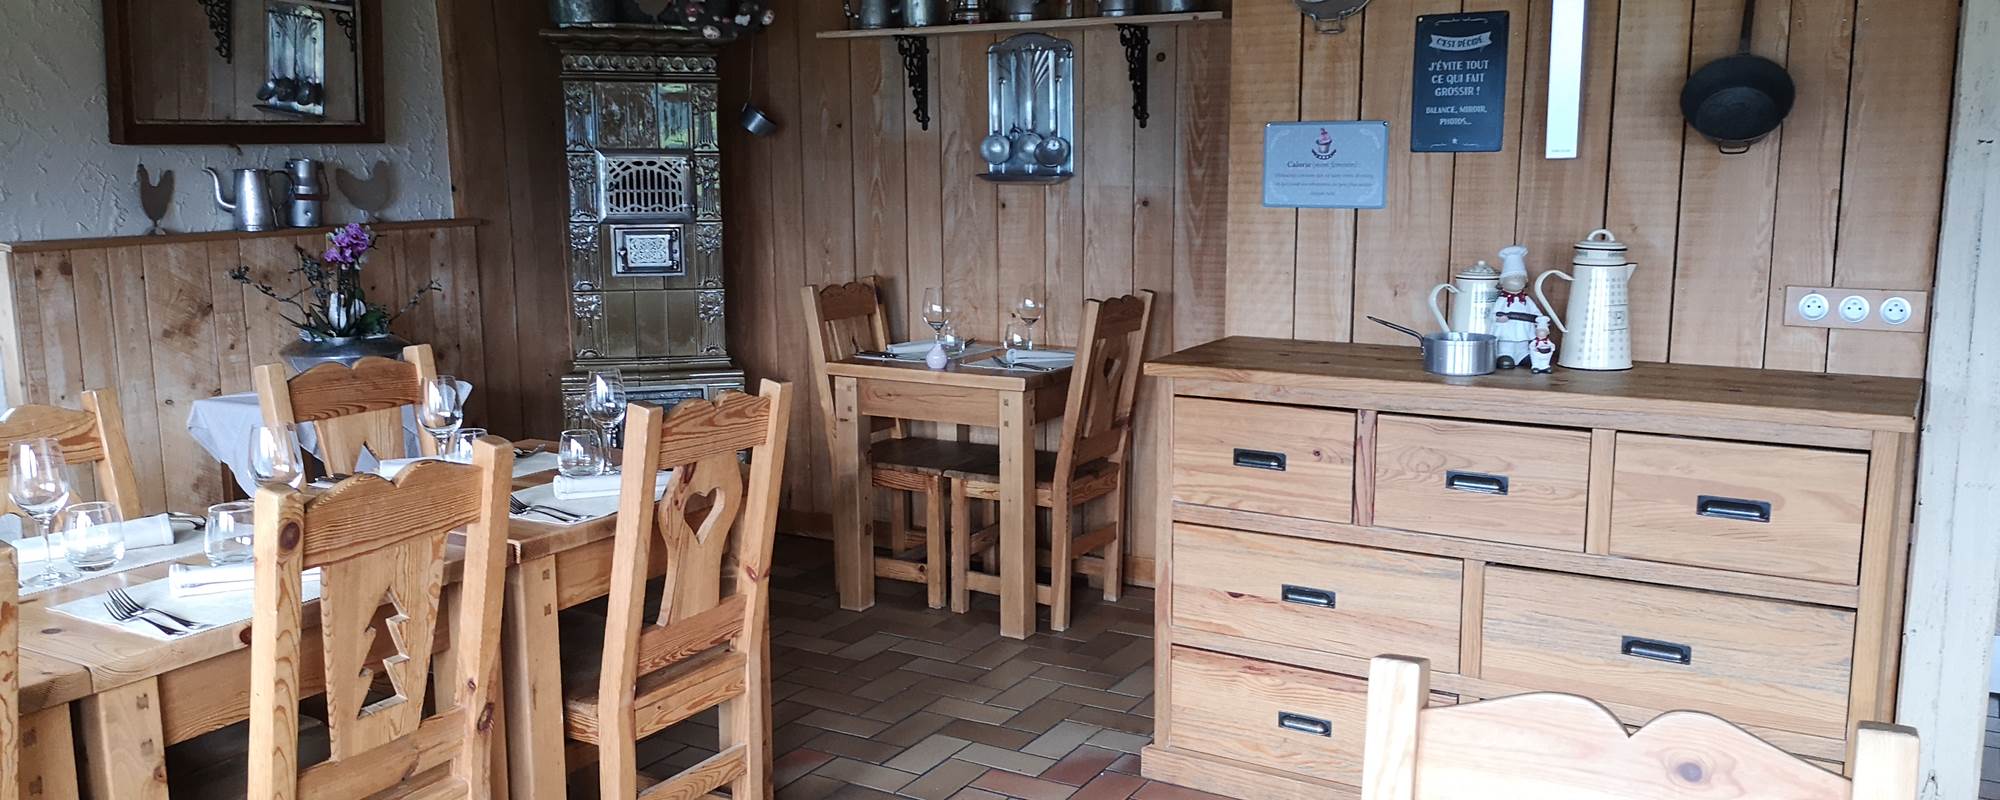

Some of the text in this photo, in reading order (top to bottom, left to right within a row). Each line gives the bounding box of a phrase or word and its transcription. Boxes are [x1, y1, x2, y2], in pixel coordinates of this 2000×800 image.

[1428, 60, 1489, 71] J'ÉVITE TOUT
[1431, 73, 1485, 84] CE QUI FAIT
[1434, 86, 1474, 96] GROSSIR
